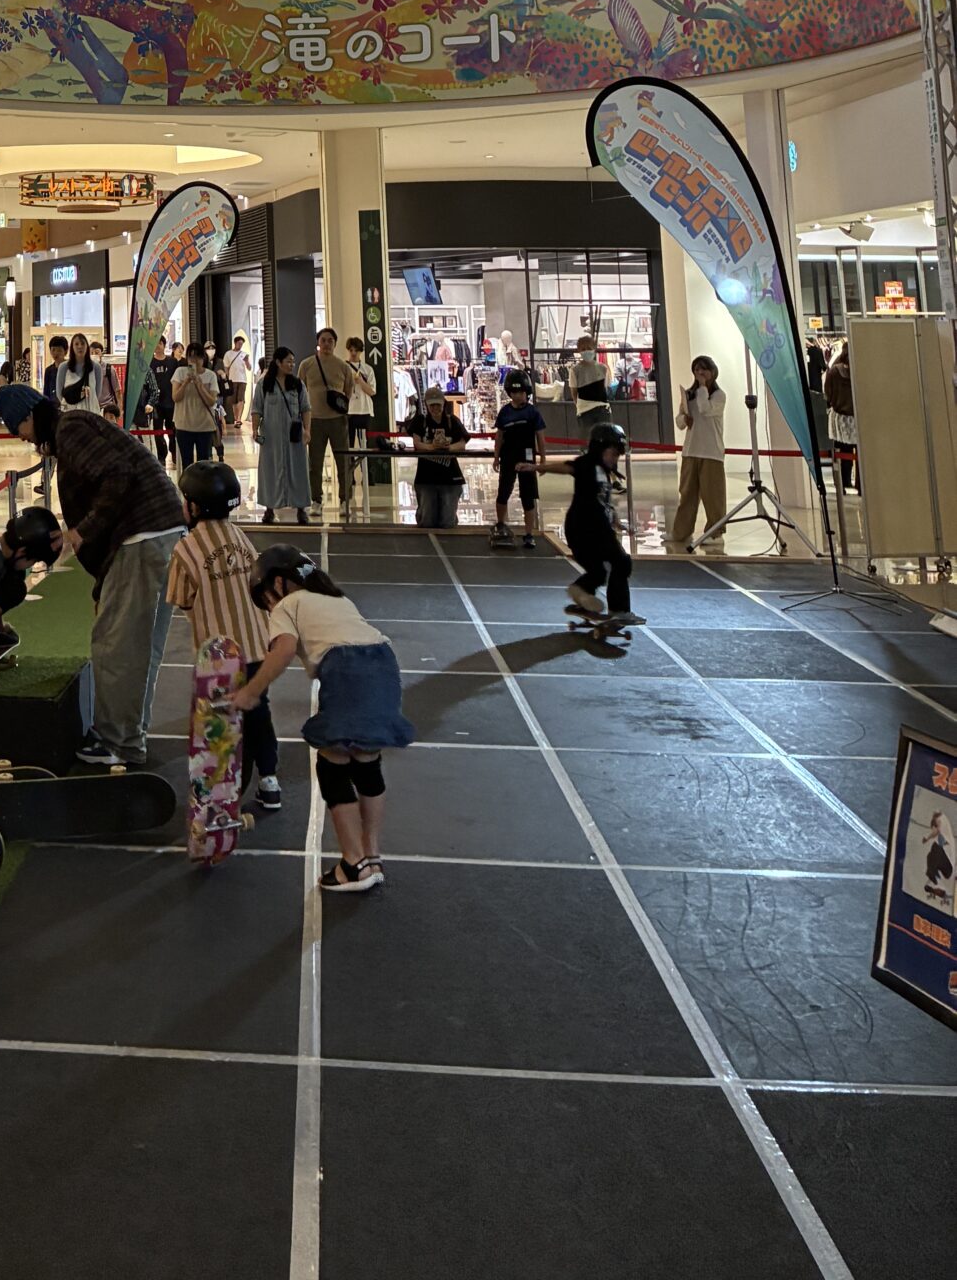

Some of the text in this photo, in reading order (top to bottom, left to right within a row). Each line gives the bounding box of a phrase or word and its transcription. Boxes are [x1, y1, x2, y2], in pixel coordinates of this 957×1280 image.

[260, 11, 517, 74] 滝のコート
[49, 177, 114, 193] レストラン街
